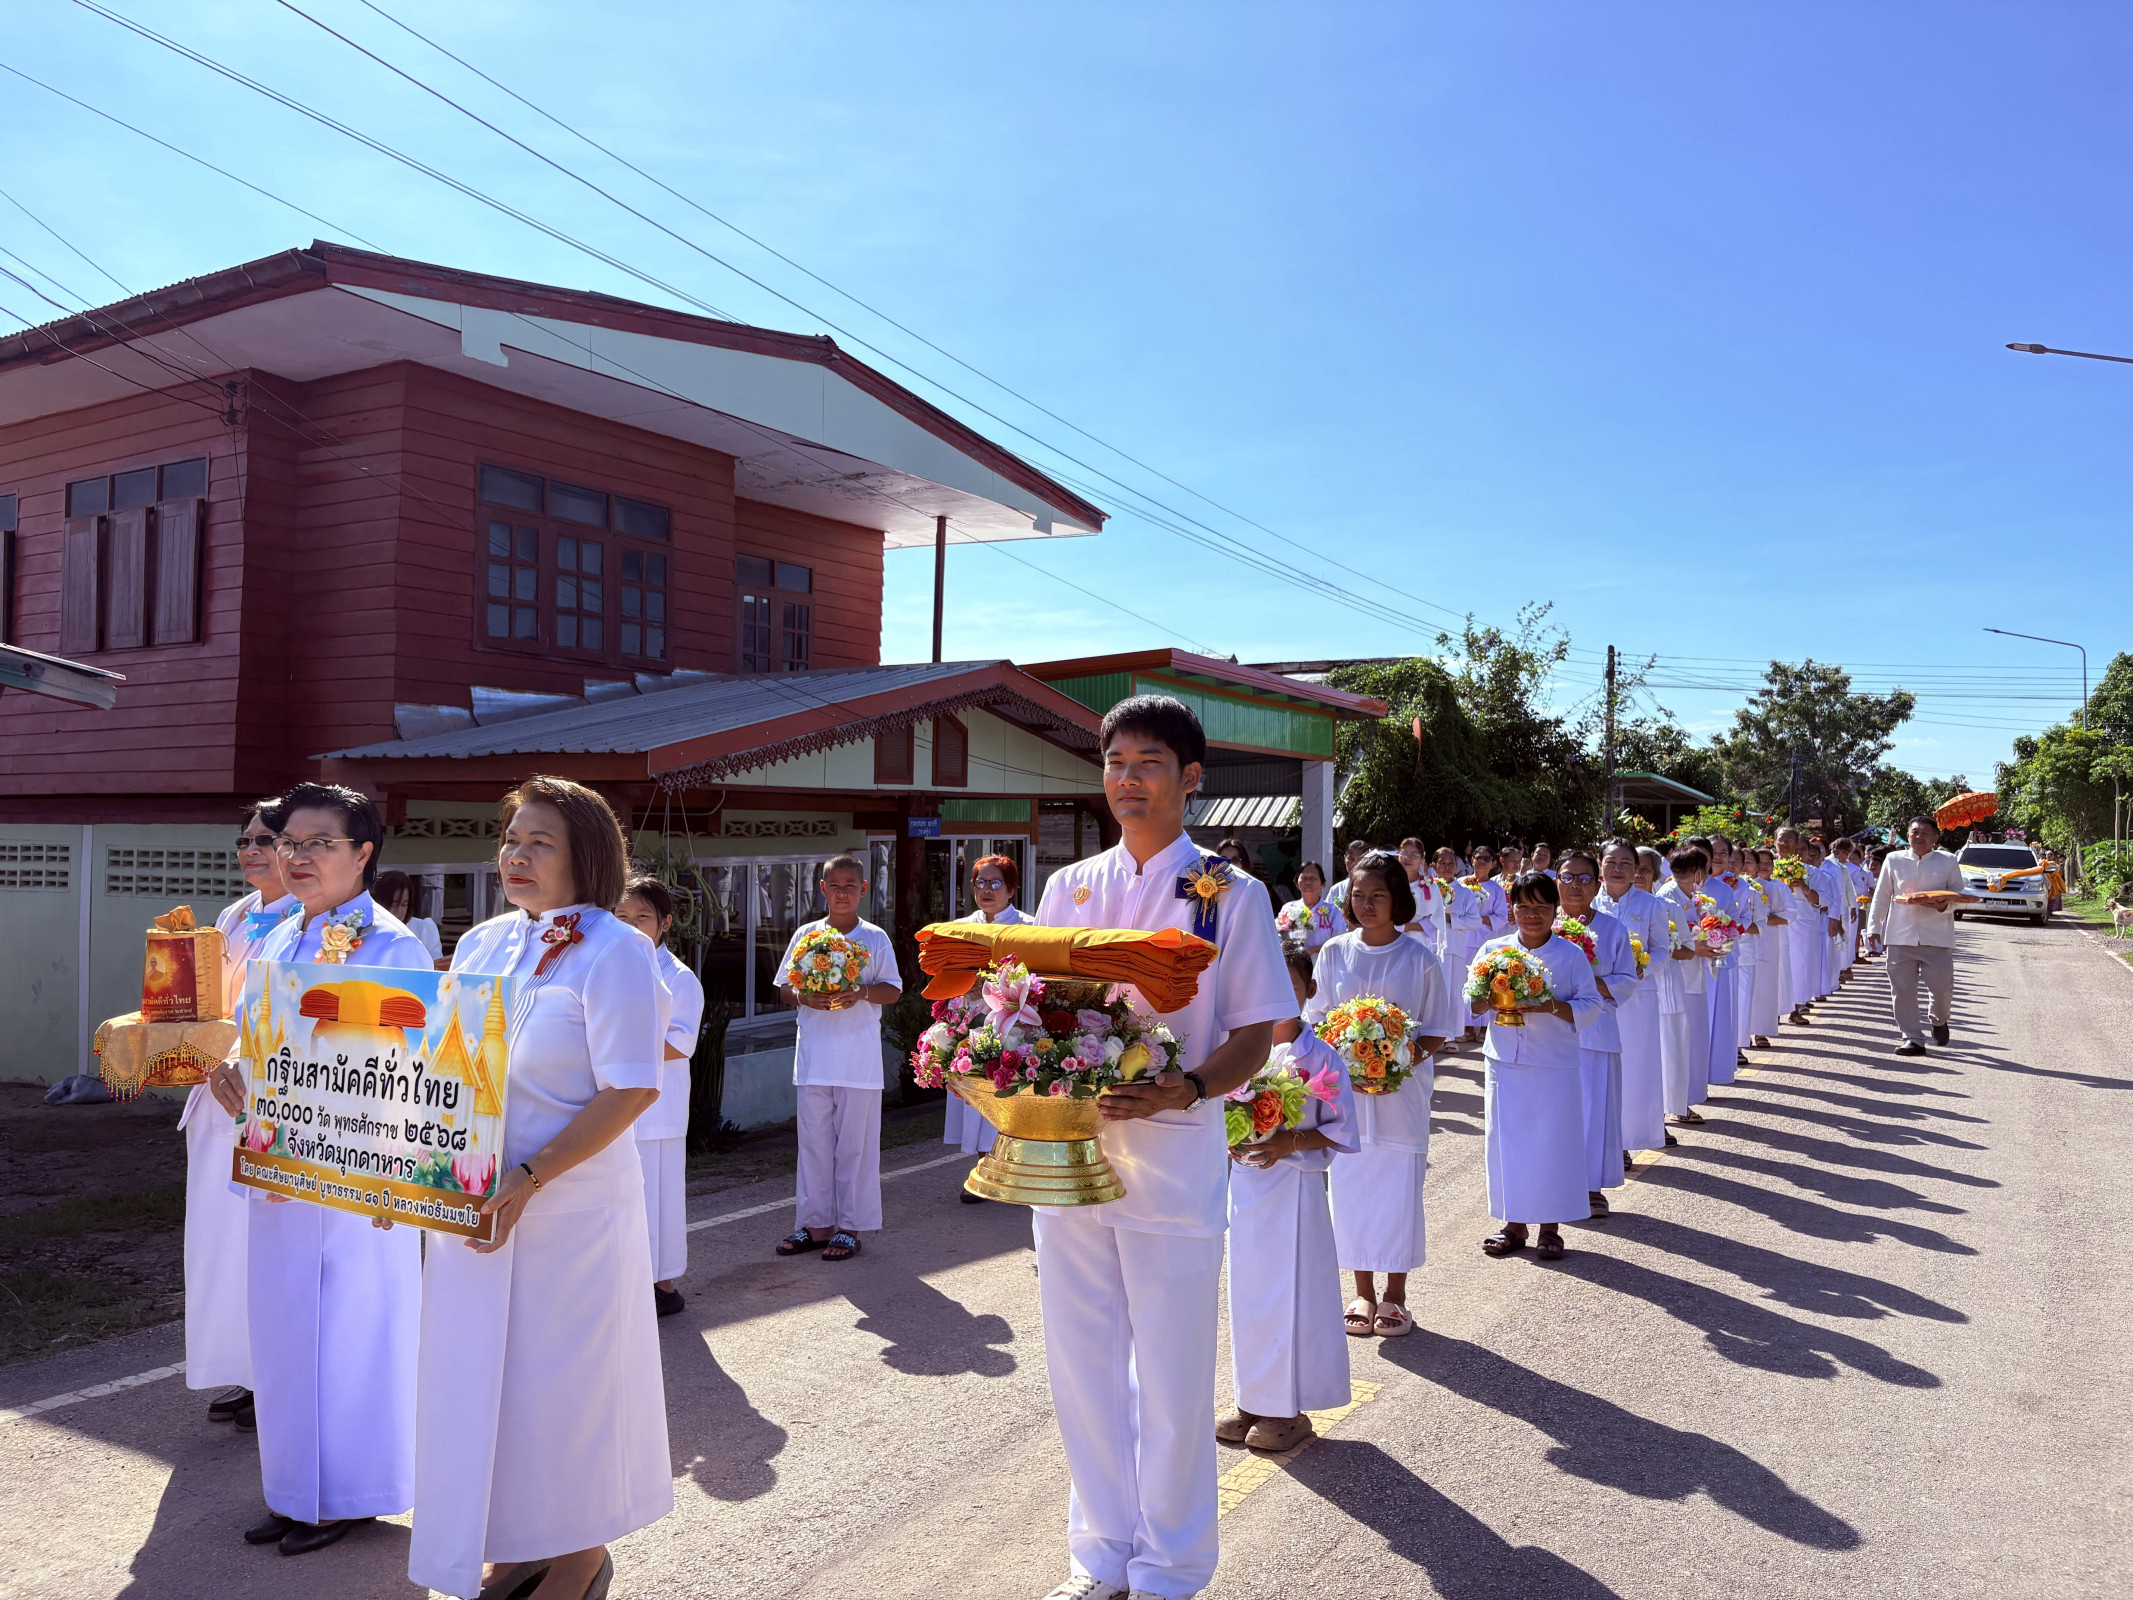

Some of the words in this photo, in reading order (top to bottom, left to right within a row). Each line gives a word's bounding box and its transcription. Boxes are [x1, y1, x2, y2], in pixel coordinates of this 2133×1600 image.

[267, 1046, 460, 1109] กฐินสามัคคีทั่วไทย
[256, 1097, 313, 1125] ๓๐,๐๐๐
[317, 1105, 331, 1129] วัด
[334, 1112, 398, 1140] พุทธศักราช
[404, 1119, 467, 1151] ๒๕๖๘
[287, 1128, 417, 1179] จังหวัดมุกดาหาร
[241, 1157, 254, 1175] โดย
[256, 1166, 317, 1193] คณะศิษยานุศิษย์
[320, 1181, 362, 1201] บูชาธรรม
[365, 1192, 379, 1206] ๘๑
[382, 1189, 390, 1207] ปี
[394, 1197, 479, 1225] หลวงพ่อธัมมชโย
